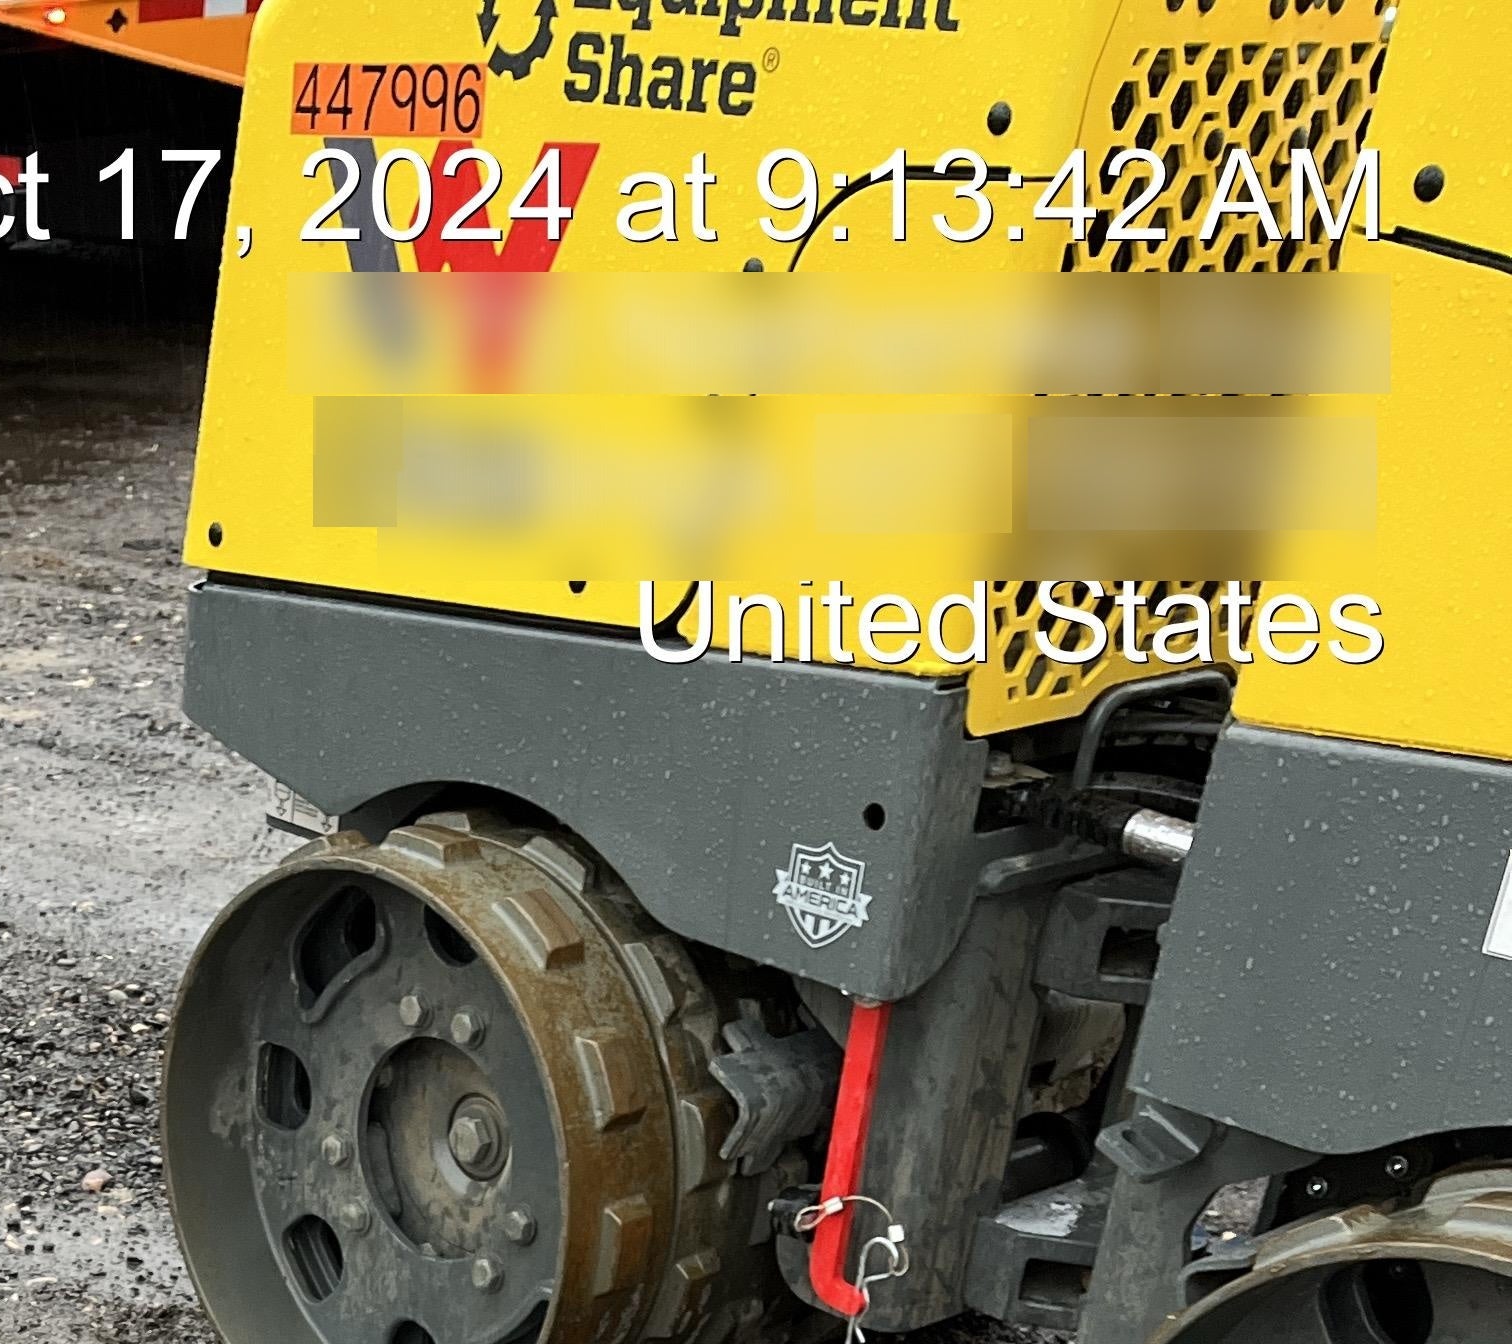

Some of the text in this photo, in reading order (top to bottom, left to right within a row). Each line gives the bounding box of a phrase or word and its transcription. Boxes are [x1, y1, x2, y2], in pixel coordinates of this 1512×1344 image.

[294, 63, 482, 134] 447996
[563, 31, 758, 118] Share
[783, 883, 859, 919] AMERICA
